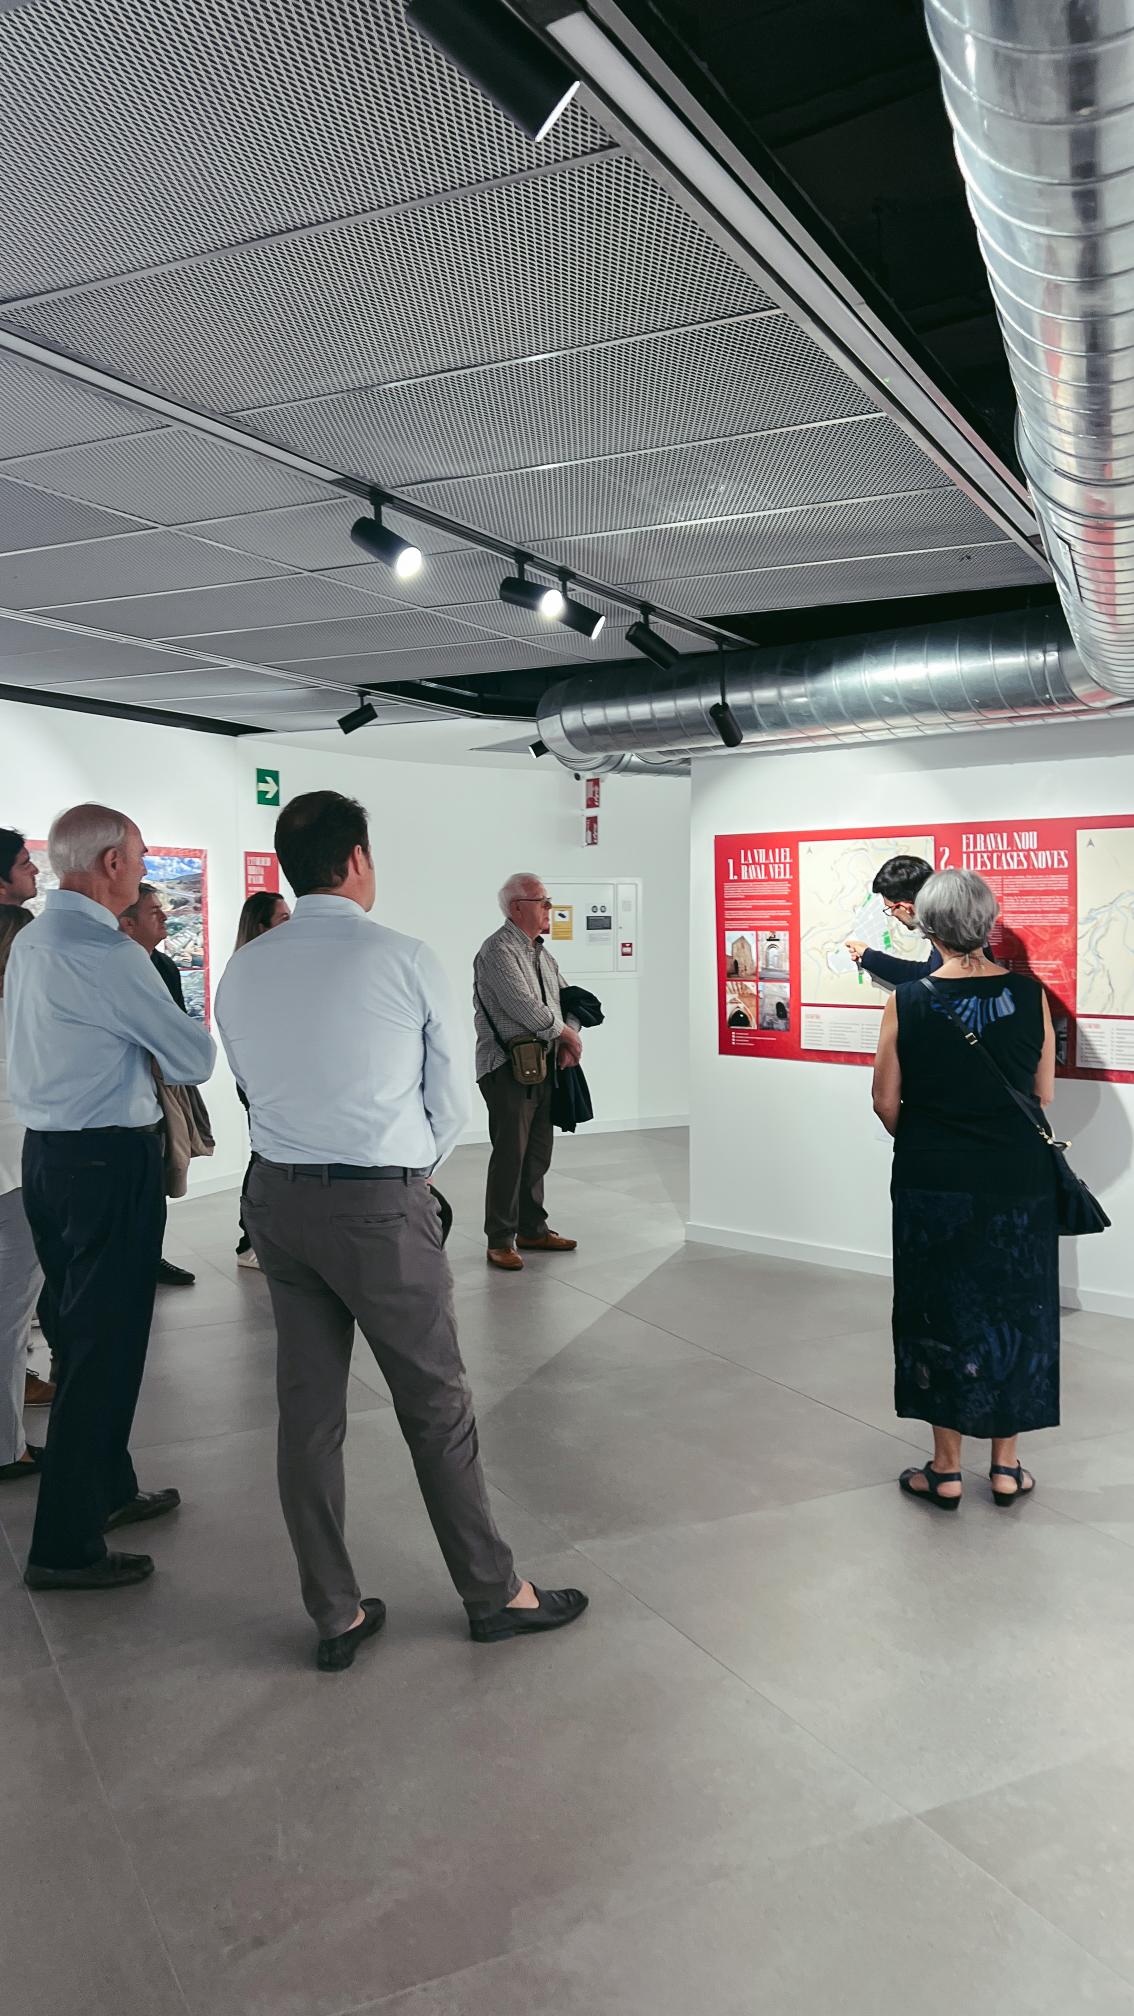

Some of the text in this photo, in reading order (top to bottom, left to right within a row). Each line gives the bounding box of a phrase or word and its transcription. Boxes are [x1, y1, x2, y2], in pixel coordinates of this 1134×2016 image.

[976, 832, 1012, 851] RAVAL
[1013, 831, 1038, 850] NOU
[741, 849, 753, 864] LA
[992, 851, 1028, 870] CASES
[1030, 849, 1069, 869] NOVES
[741, 863, 793, 880] RAVAL VELL
